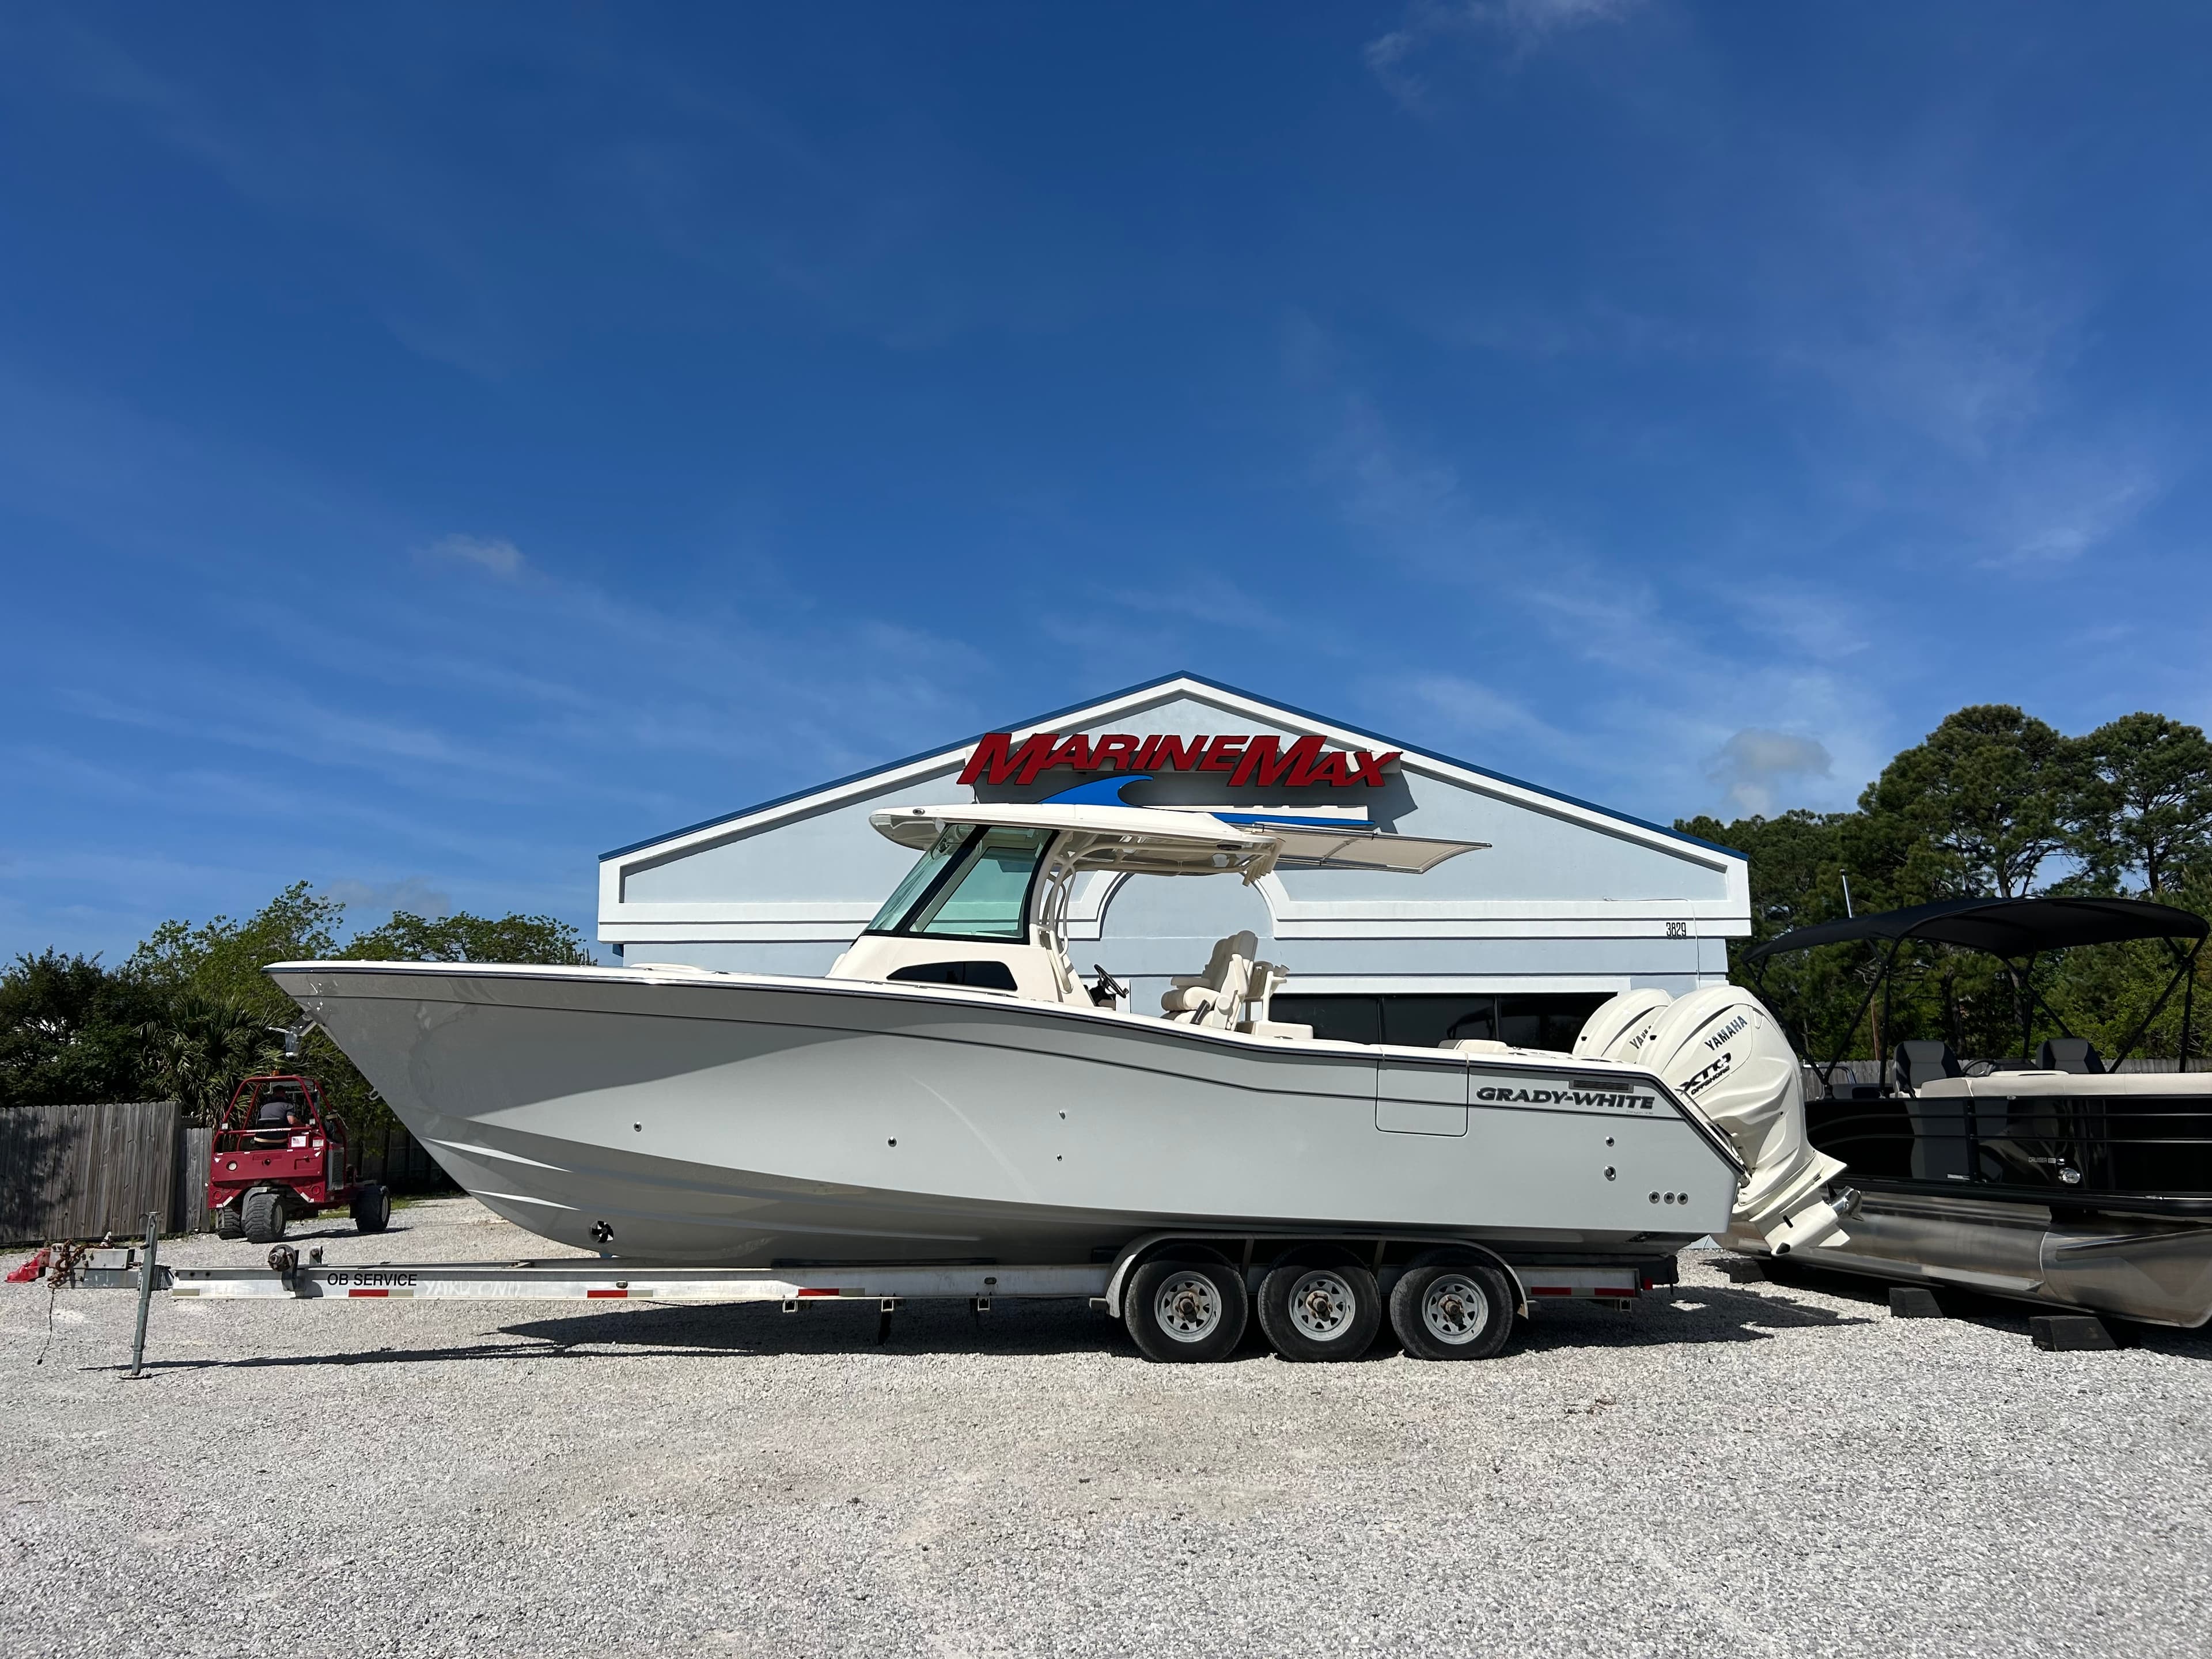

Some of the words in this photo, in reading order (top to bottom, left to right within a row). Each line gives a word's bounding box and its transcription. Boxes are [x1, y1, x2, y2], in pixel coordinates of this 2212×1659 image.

[1666, 922, 1687, 937] 3829
[1704, 1015, 1748, 1051] YAMAHA
[1691, 1065, 1730, 1095] OFFSHORE
[1476, 1087, 1655, 1109] GRADY-WHITE
[327, 1272, 349, 1286] OB
[353, 1273, 418, 1286] SERVICE
